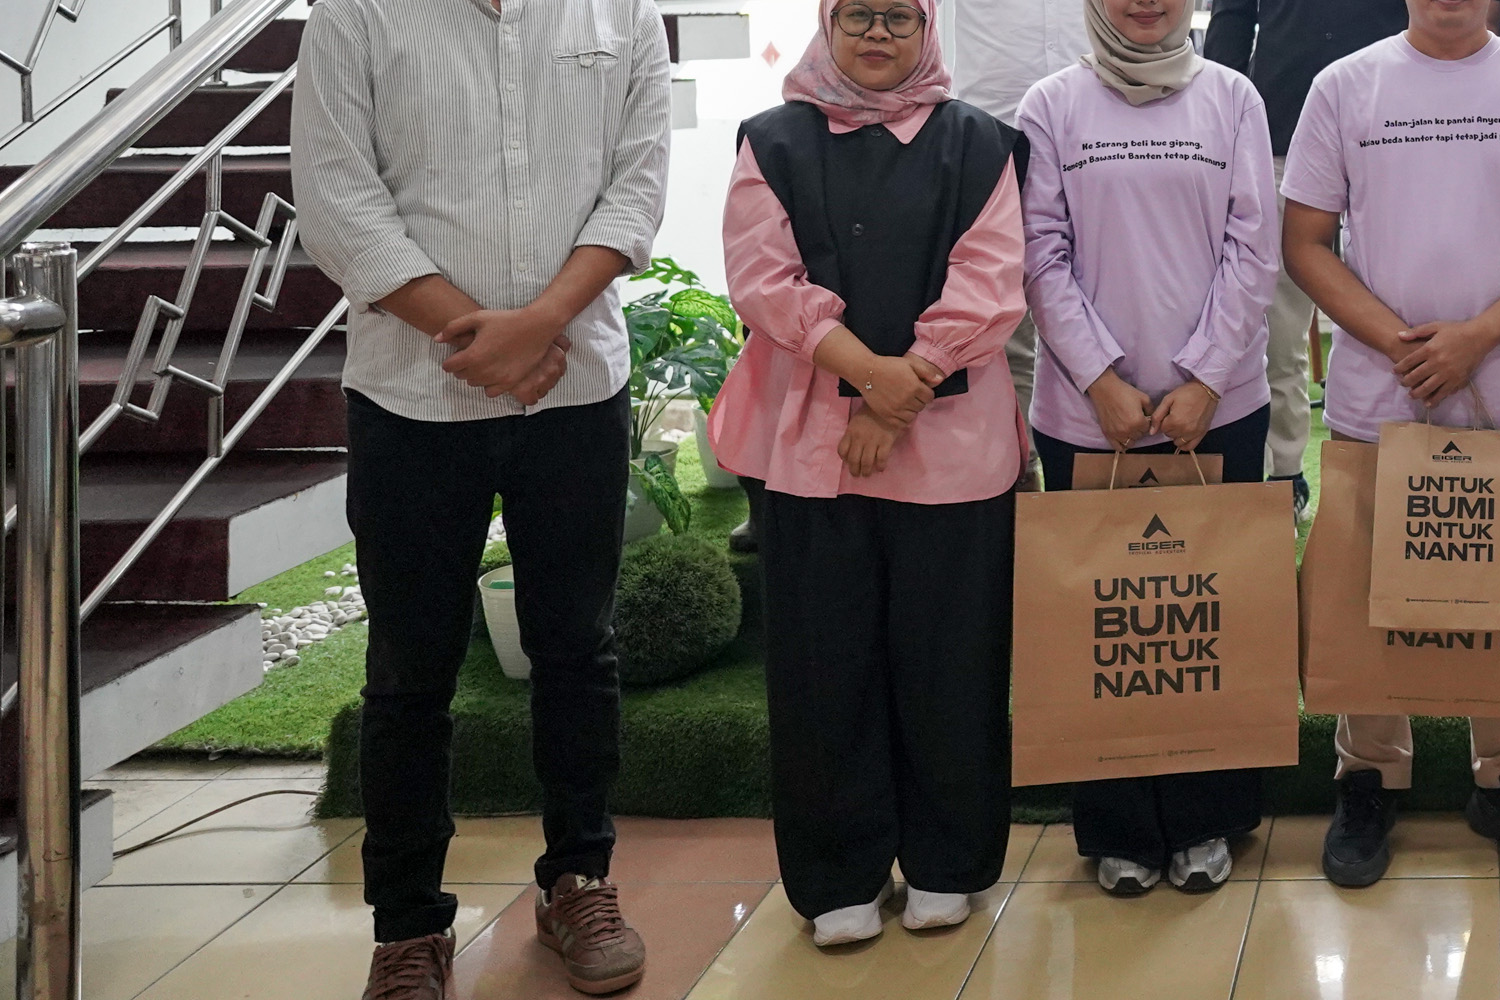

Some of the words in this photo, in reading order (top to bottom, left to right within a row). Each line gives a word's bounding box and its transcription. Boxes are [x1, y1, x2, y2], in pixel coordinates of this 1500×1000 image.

[1384, 118, 1433, 129] Jalan-jalan
[1435, 117, 1445, 125] ke
[1446, 116, 1475, 126] pantai
[1095, 141, 1128, 150] Serang
[1131, 139, 1149, 147] beli
[1150, 139, 1167, 147] kue
[1169, 139, 1203, 150] gipang,
[1382, 136, 1403, 145] beda
[1405, 134, 1434, 143] kantor
[1435, 134, 1454, 143] tapi
[1455, 132, 1479, 141] tetap
[1478, 132, 1497, 143] jadi
[1089, 152, 1126, 163] Bawaslu
[1128, 152, 1162, 160] Banten
[1164, 152, 1190, 161] tetap
[1408, 475, 1494, 494] UNTUK
[1407, 495, 1494, 520] BUMI
[1406, 521, 1493, 540] UNTUK
[1128, 540, 1186, 551] EIGER
[1405, 541, 1493, 562] NANTI
[1094, 572, 1219, 602] UNTUK
[1094, 601, 1220, 638] BUMI
[1094, 637, 1219, 666] UNTUK
[1094, 665, 1220, 699] NANTI
